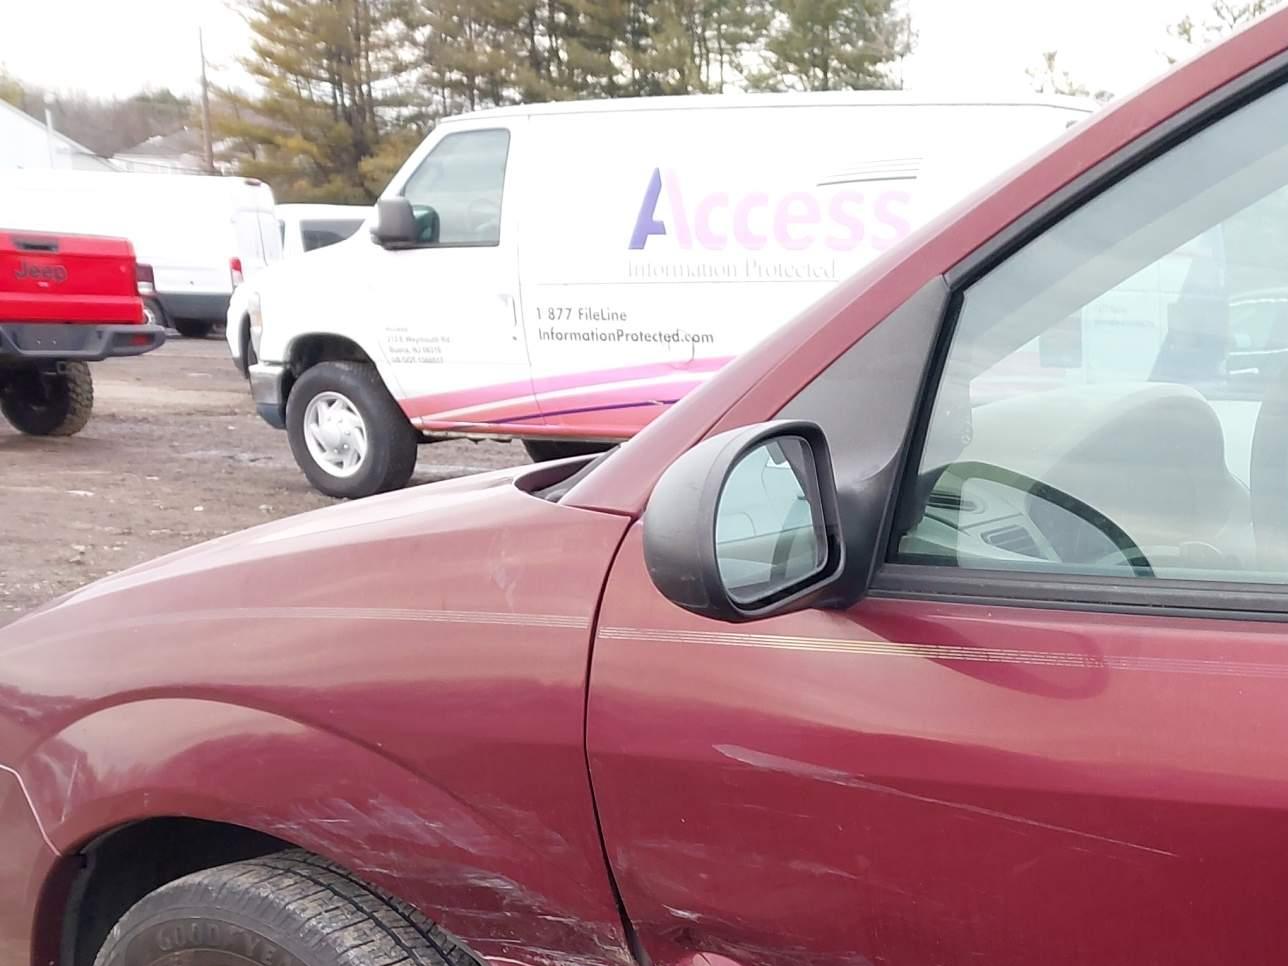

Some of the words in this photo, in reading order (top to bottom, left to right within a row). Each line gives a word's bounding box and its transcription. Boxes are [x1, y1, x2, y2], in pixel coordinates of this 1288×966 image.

[628, 167, 912, 251] Access
[15, 260, 68, 283] Jeep
[628, 258, 737, 278] Information
[745, 255, 838, 278] Protected
[536, 307, 542, 320] 1
[548, 307, 572, 321] 877
[578, 307, 627, 321] FileLine
[538, 328, 714, 343] InformationProtected.com
